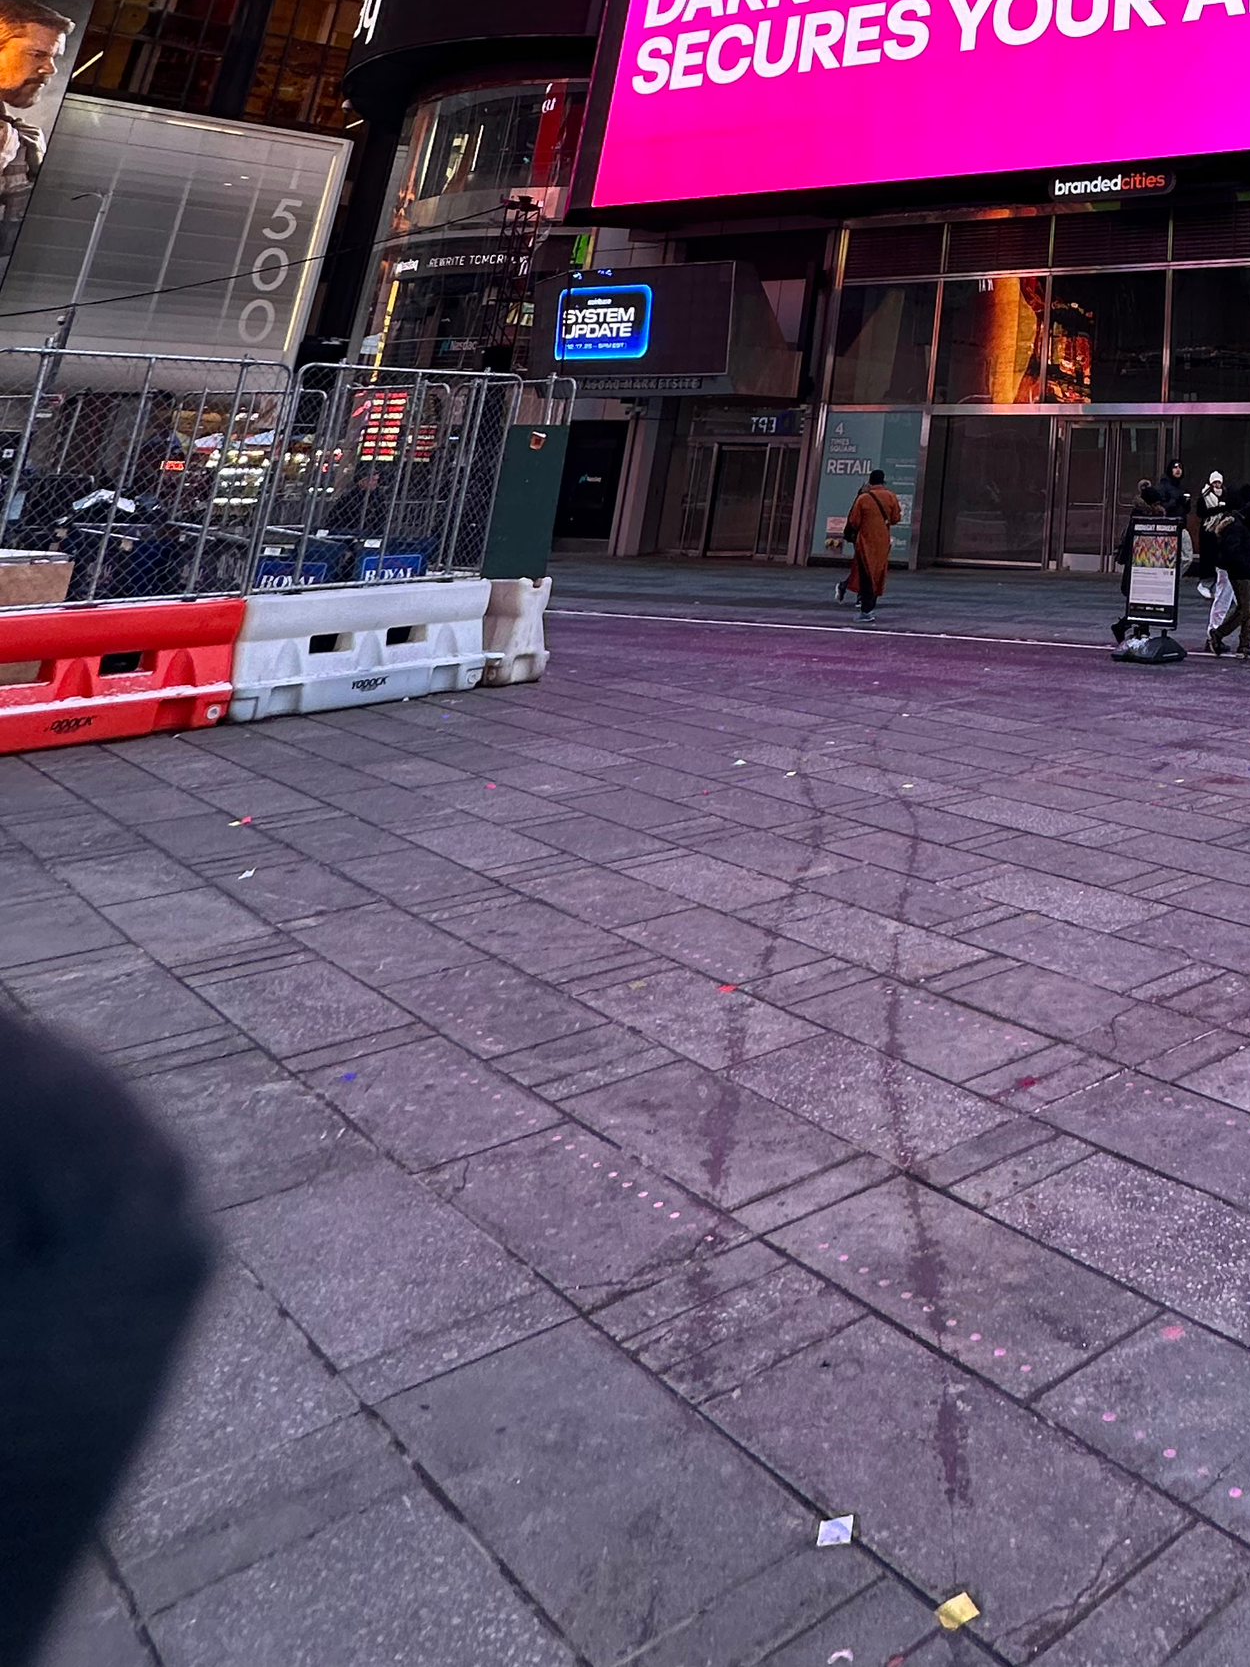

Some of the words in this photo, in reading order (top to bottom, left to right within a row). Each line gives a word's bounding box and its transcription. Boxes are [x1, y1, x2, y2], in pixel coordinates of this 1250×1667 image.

[1054, 172, 1165, 196] brandedcities
[563, 307, 635, 324] SYSTEM
[562, 322, 632, 339] UPDATE
[835, 422, 844, 435] 4
[830, 438, 850, 446] TIMES
[826, 459, 872, 475] RETAIL
